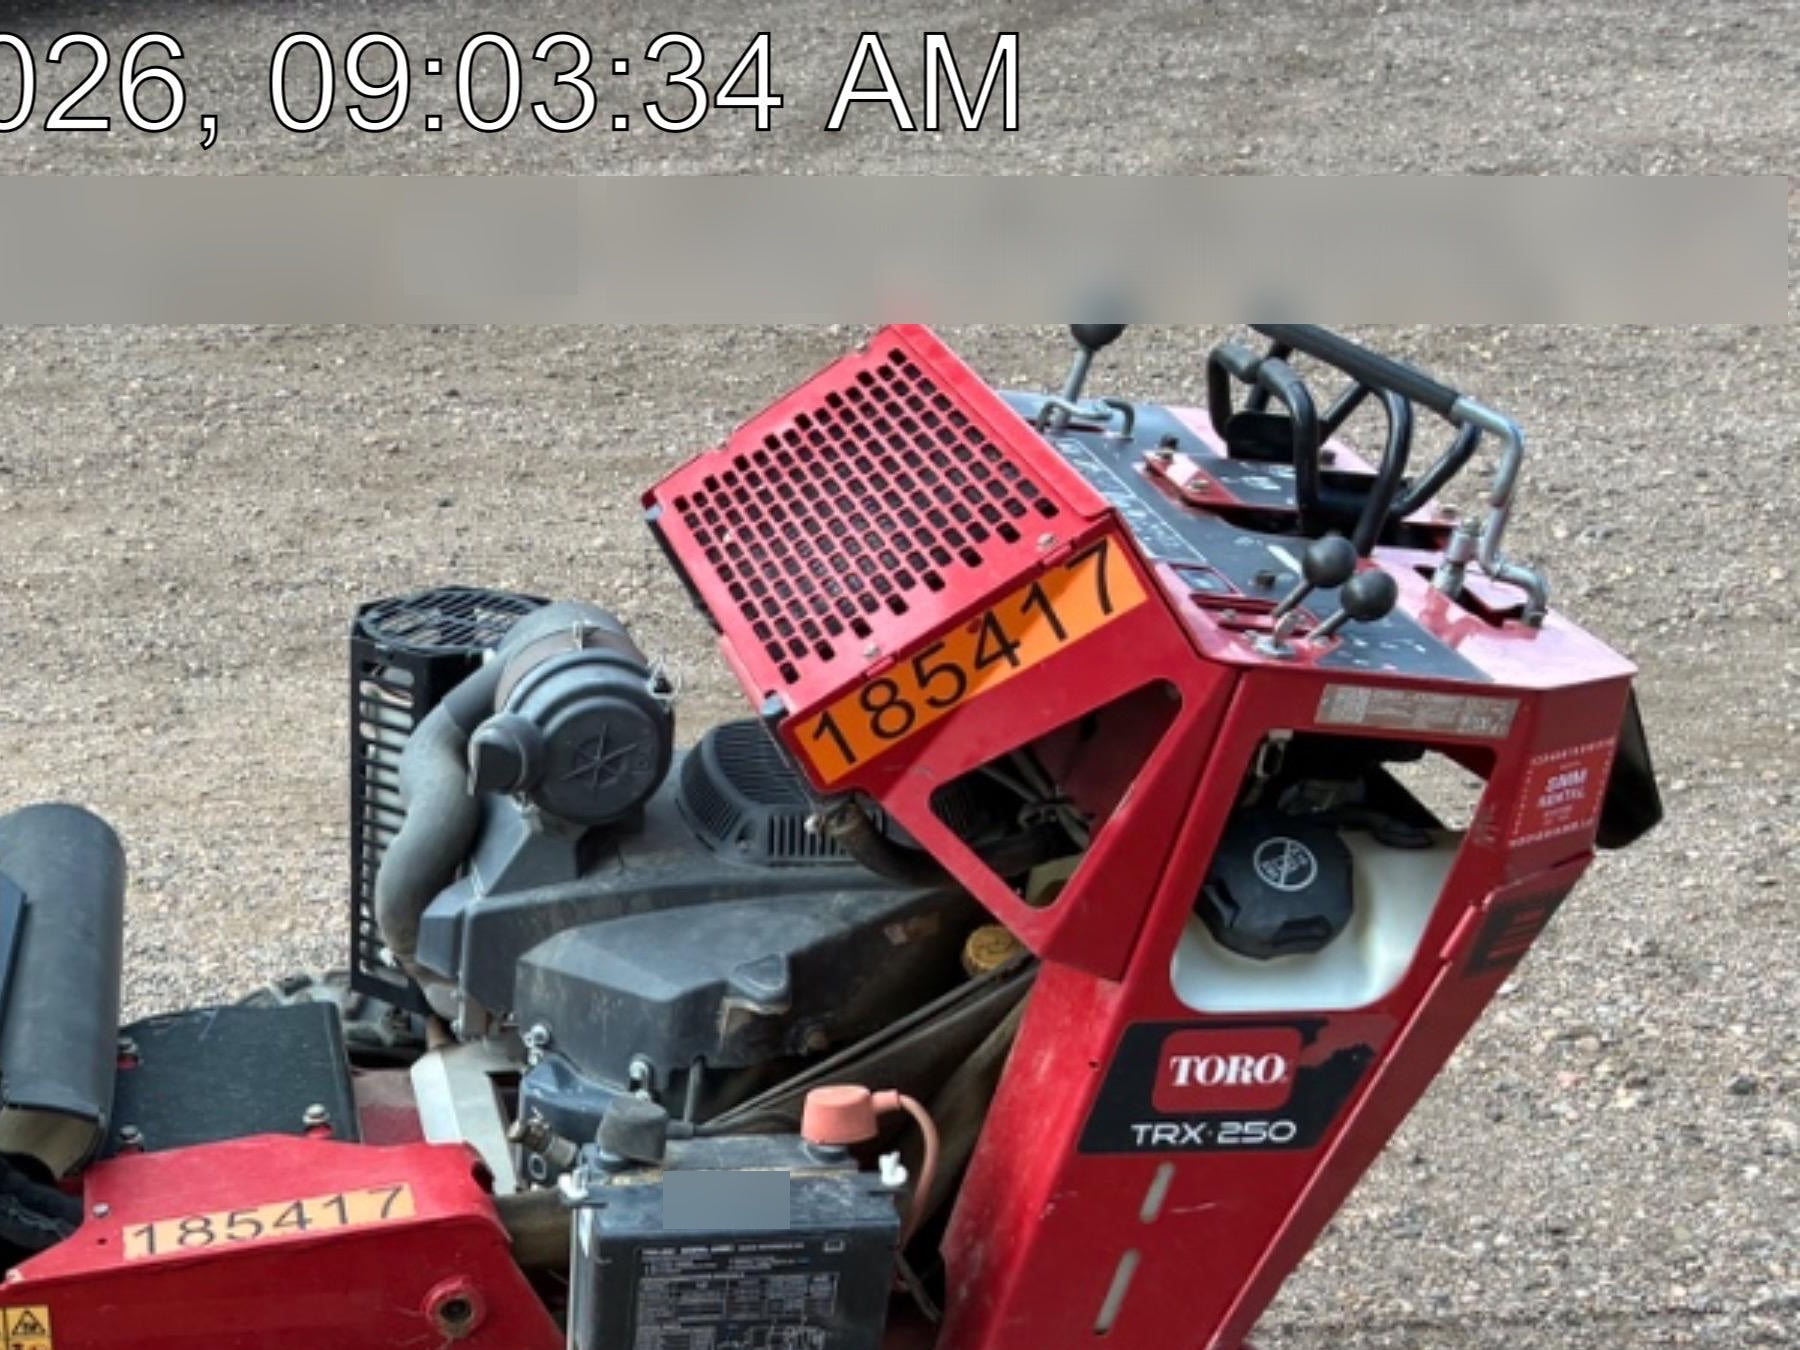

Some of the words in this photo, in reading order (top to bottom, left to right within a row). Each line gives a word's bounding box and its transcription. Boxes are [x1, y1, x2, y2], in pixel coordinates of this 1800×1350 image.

[812, 538, 1114, 766] 185417
[1169, 1053, 1286, 1087] TORO
[132, 1184, 403, 1256] 185417
